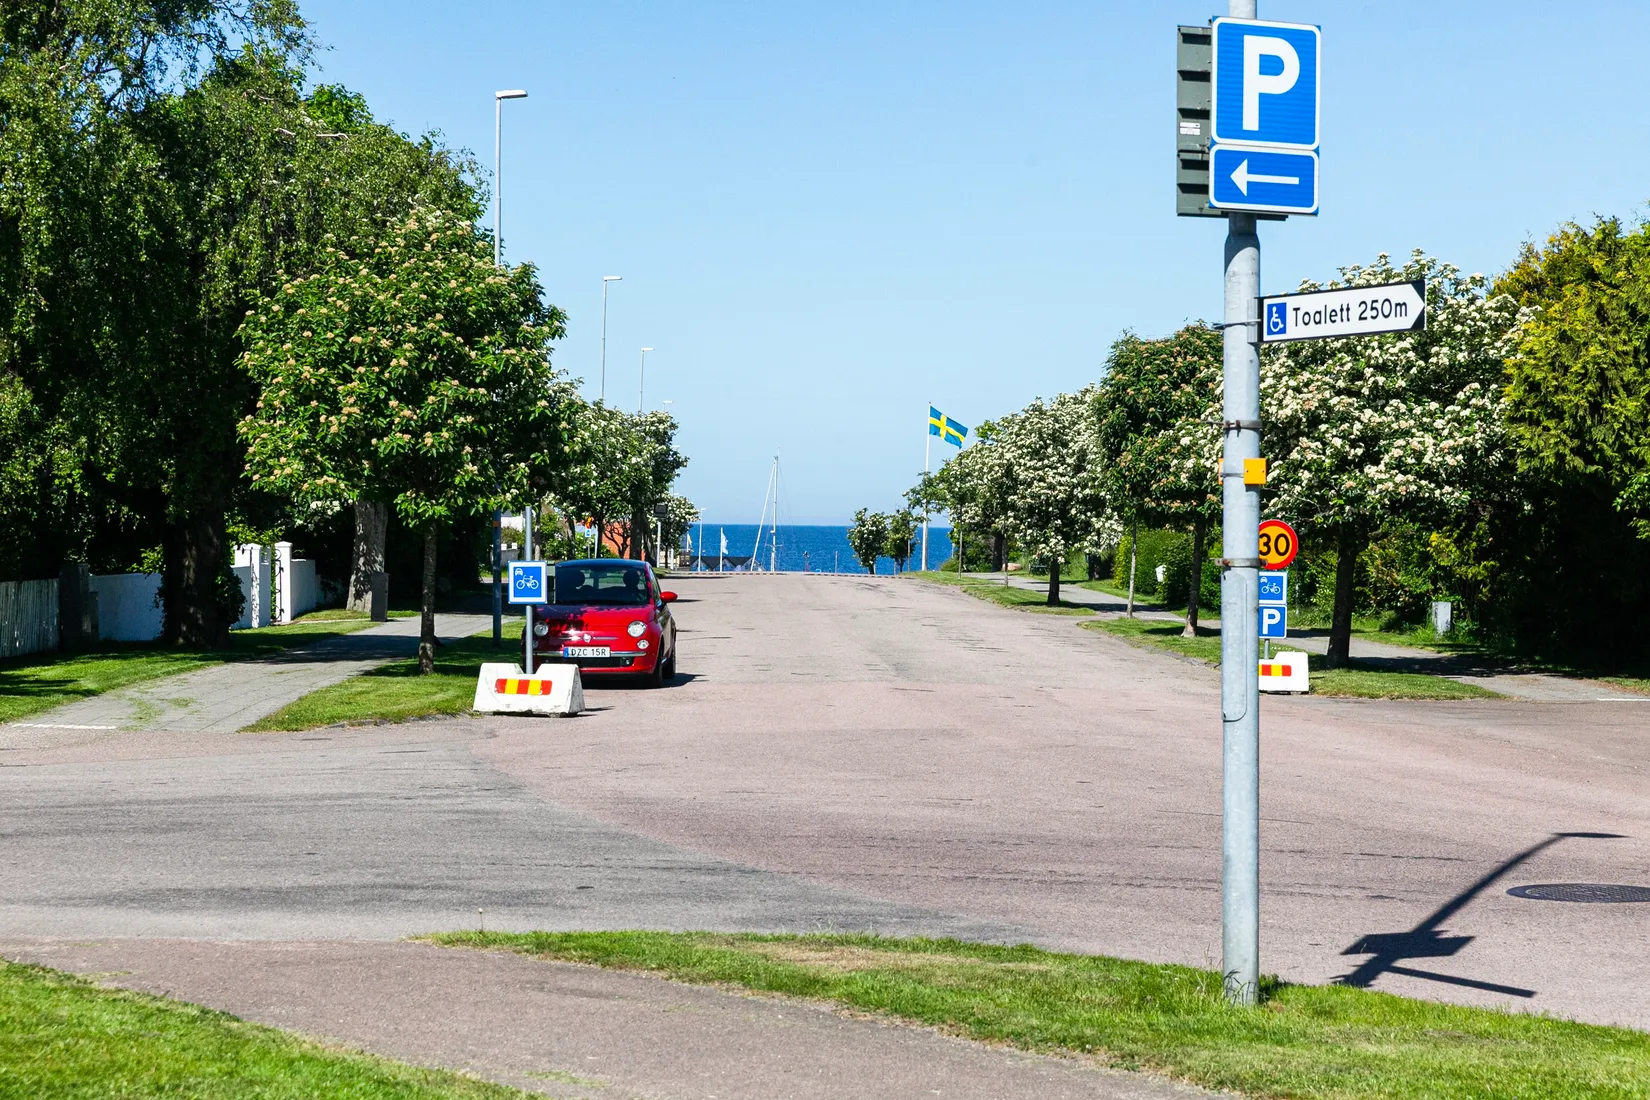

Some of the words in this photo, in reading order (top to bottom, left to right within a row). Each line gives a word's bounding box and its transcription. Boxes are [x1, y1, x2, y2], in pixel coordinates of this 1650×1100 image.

[1242, 34, 1301, 131] P
[1293, 303, 1351, 327] Toalett
[1358, 298, 1408, 321] 250m
[1259, 533, 1290, 556] 30
[1262, 608, 1281, 635] P
[571, 648, 588, 657] DZC
